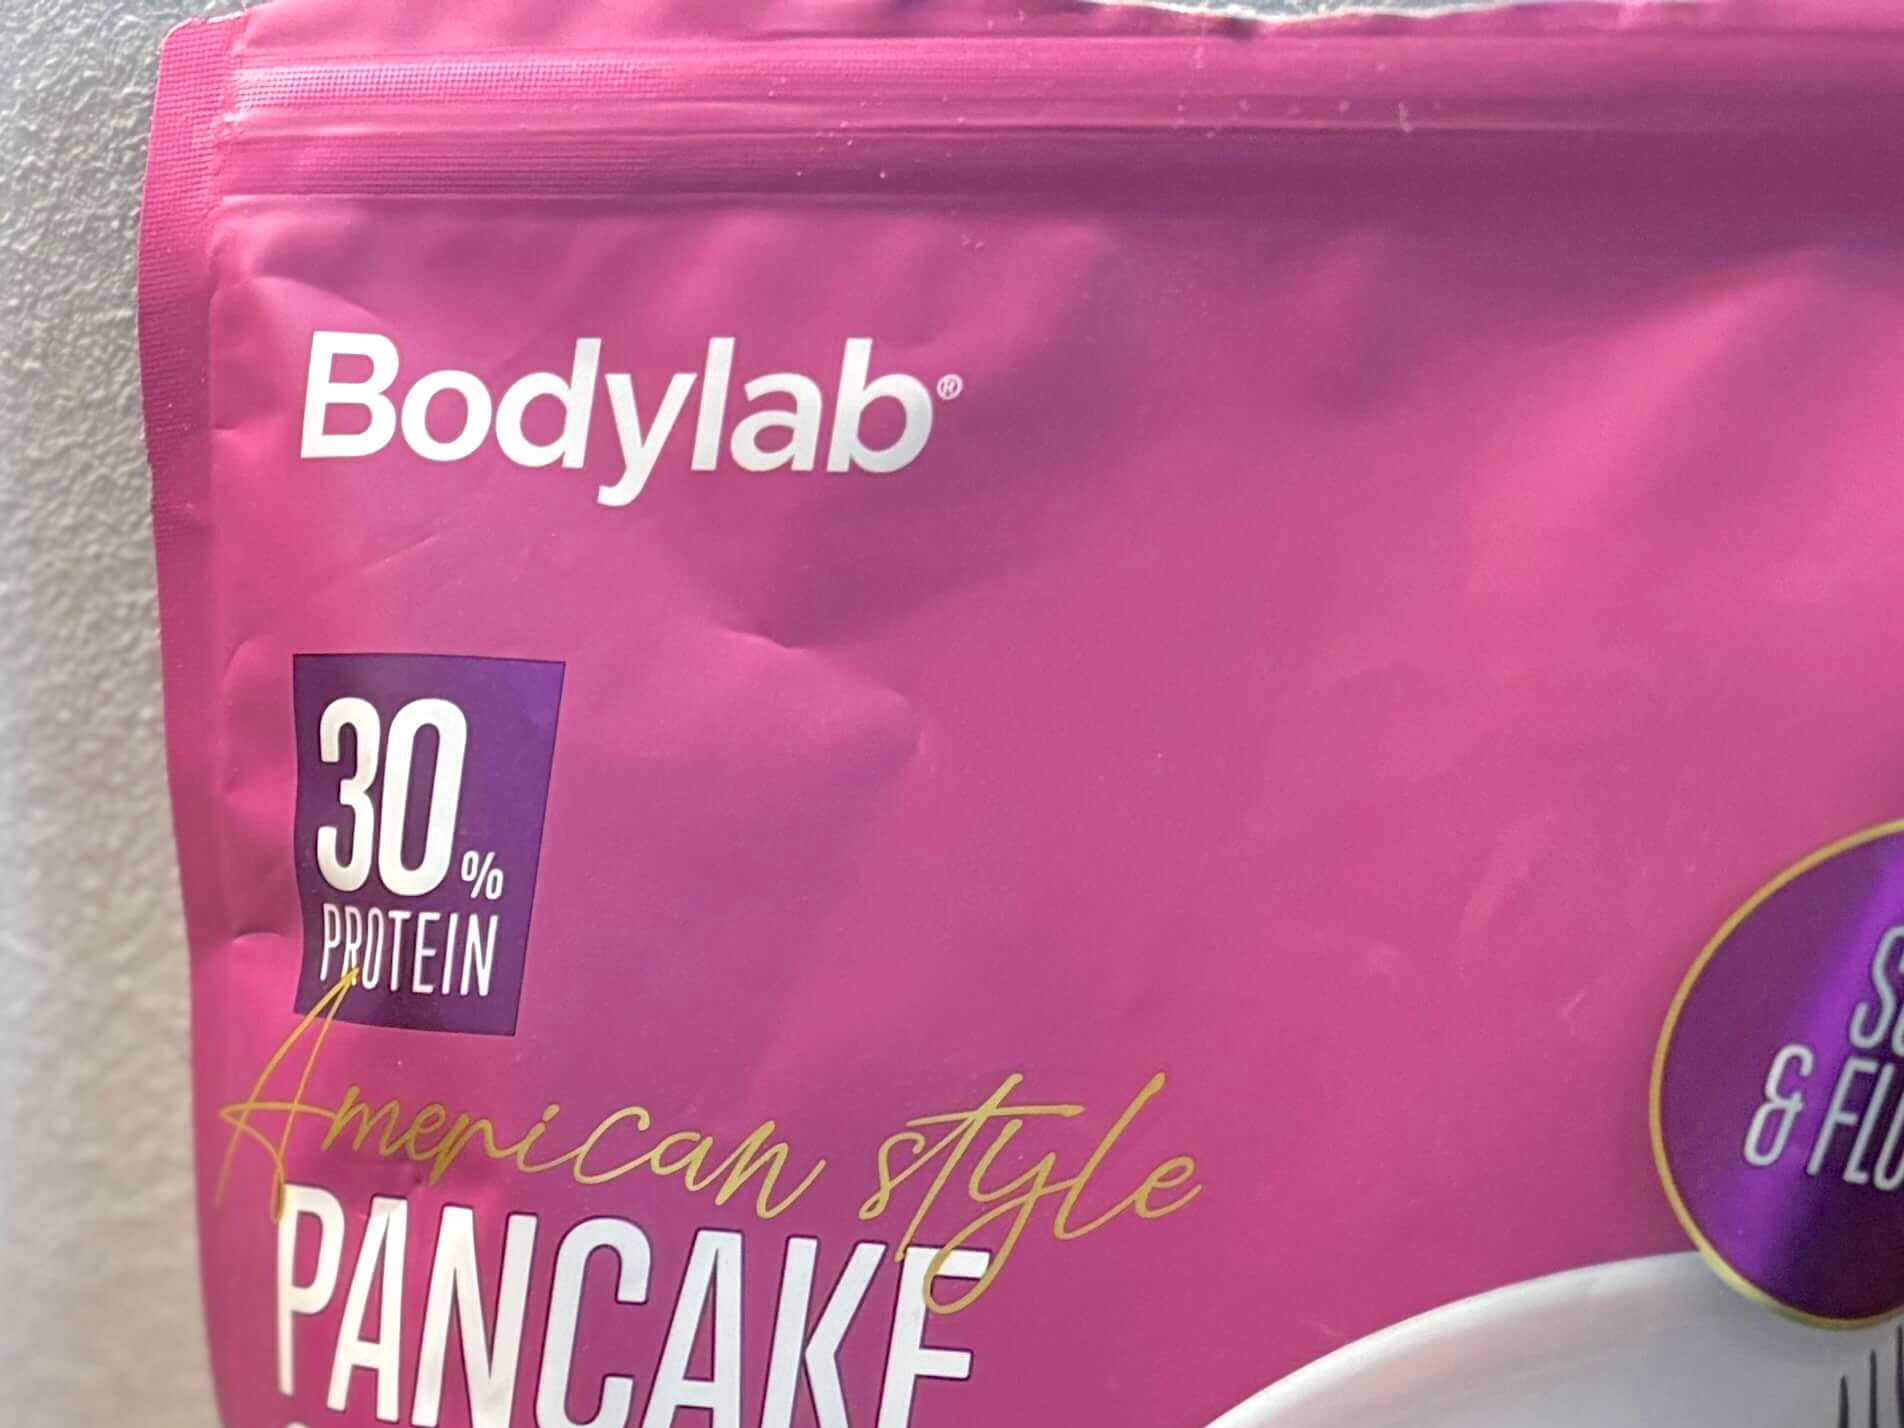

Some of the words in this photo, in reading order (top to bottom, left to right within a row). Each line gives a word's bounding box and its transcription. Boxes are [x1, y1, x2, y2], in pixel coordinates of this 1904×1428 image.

[316, 697, 504, 900] 30%
[319, 902, 499, 997] PROTEIN
[1849, 926, 1904, 1056] S
[211, 966, 824, 1224] American
[858, 1072, 1202, 1314] style
[1743, 1044, 1814, 1166] &
